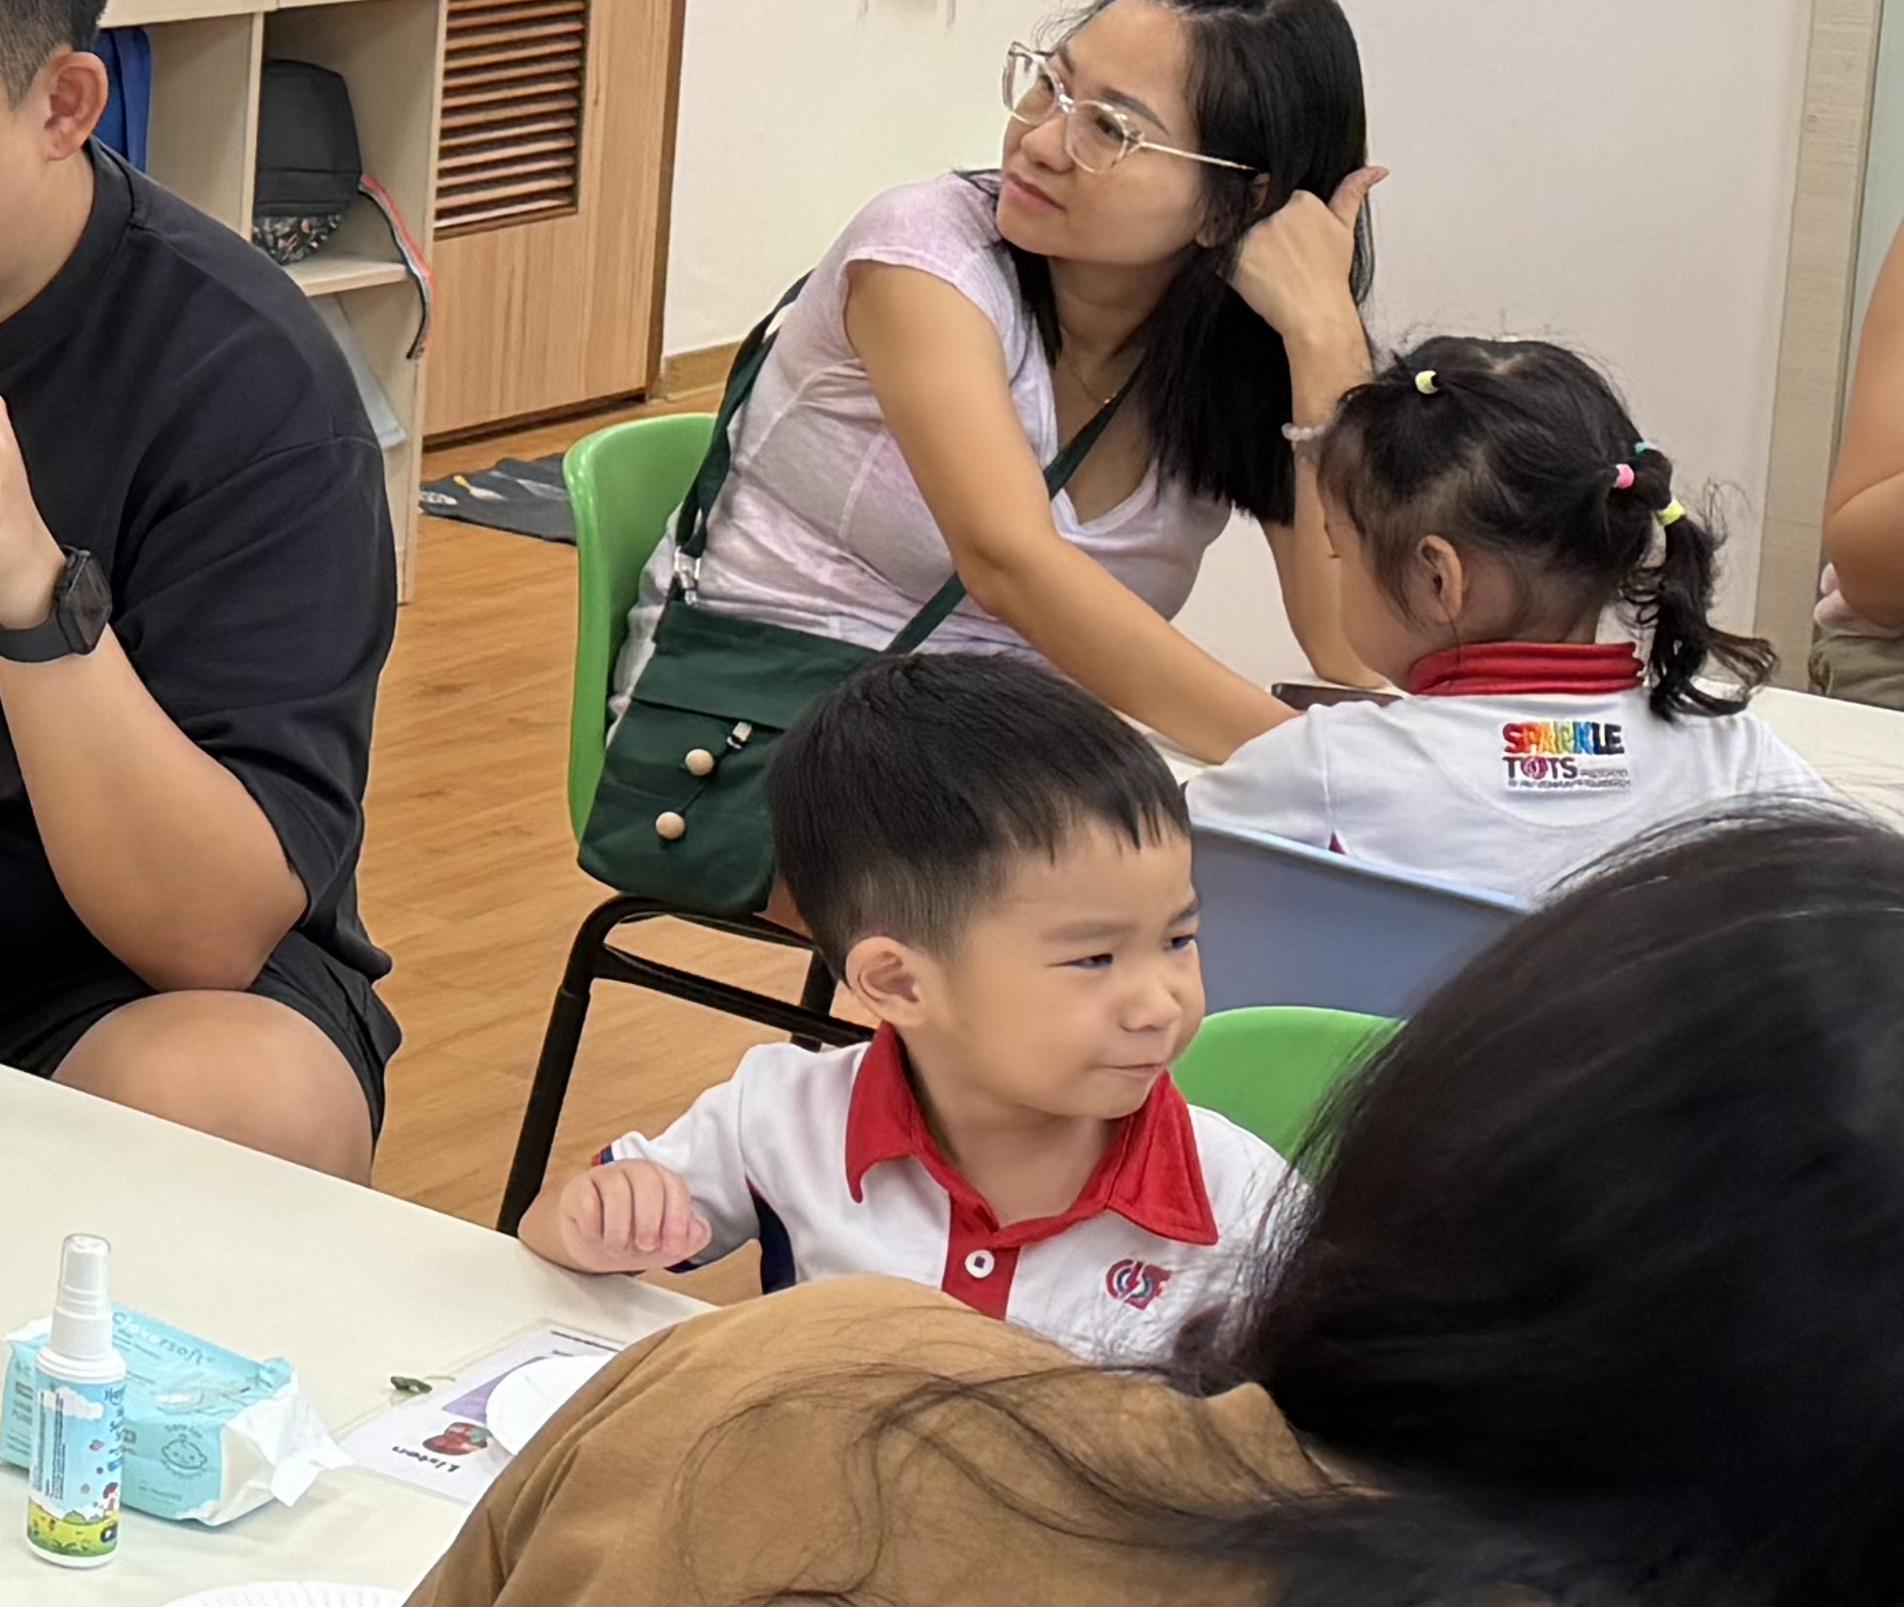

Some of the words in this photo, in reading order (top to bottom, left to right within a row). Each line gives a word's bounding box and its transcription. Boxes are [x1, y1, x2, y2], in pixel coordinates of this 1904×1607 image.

[1502, 720, 1626, 756] SPARKLE
[1502, 755, 1578, 781] TOTS
[392, 1444, 461, 1474] Listen
